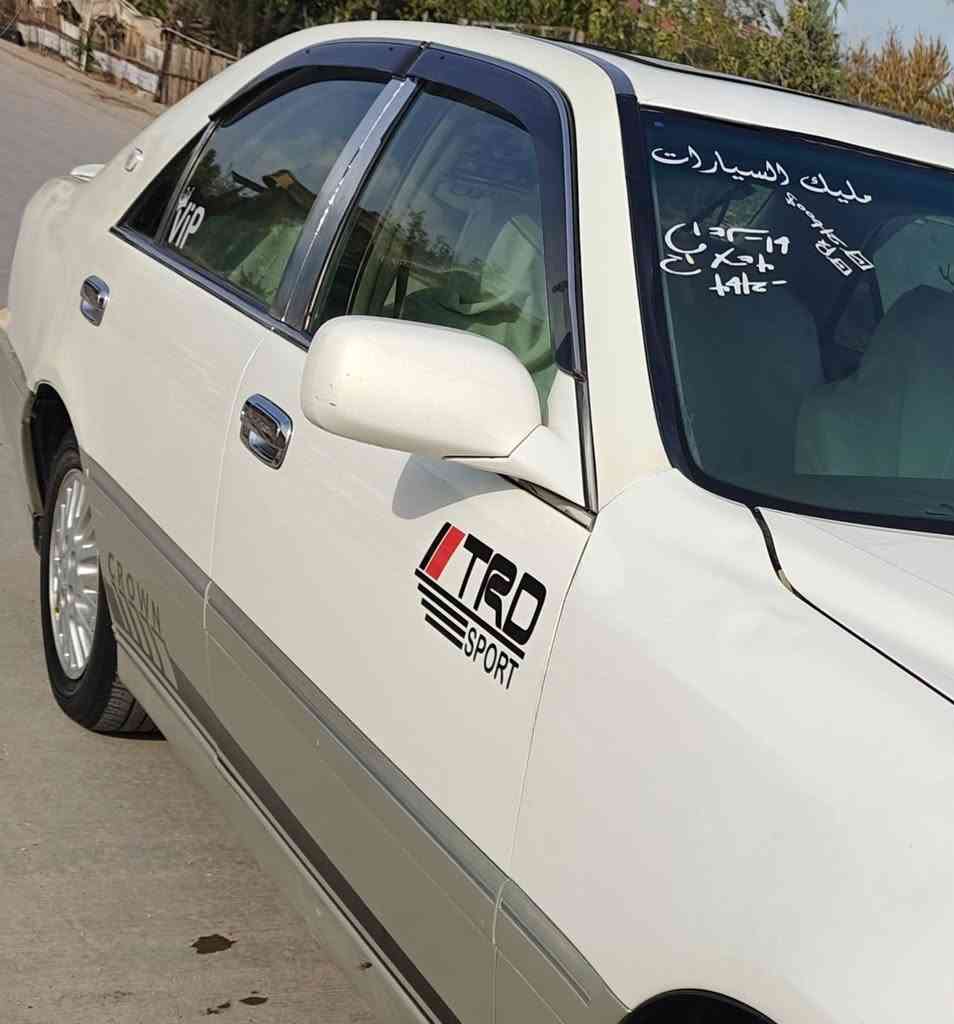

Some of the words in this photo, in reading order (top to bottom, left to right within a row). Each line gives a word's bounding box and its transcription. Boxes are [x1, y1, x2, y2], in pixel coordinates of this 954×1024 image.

[651, 144, 790, 186] السيارات
[463, 532, 547, 646] TRD
[464, 627, 520, 690] SPORT
